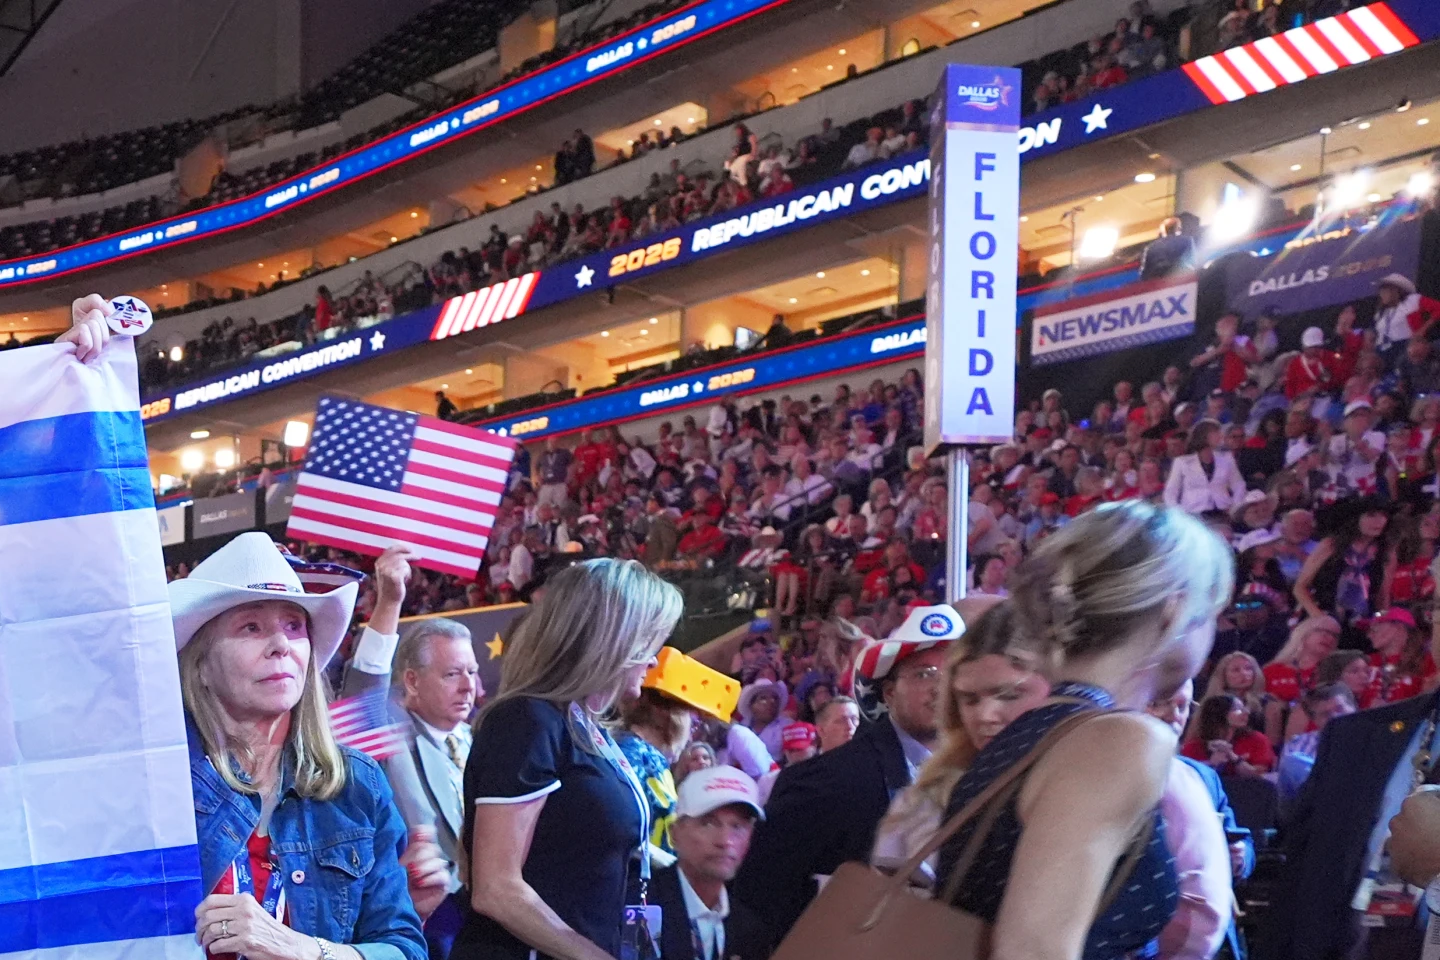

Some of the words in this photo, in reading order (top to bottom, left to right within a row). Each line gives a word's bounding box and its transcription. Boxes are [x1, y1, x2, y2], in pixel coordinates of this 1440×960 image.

[958, 85, 1000, 100] DALLAS
[607, 238, 681, 277] 2026
[691, 183, 854, 254] REPUBLICAN
[966, 152, 997, 416] FLORIDA
[1249, 266, 1329, 297] DALLAS
[1038, 292, 1189, 347] NEWSMAX
[142, 398, 171, 419] 026
[174, 370, 260, 410] REPUBLICAN
[261, 337, 361, 383] CONVENTION
[639, 383, 690, 407] DALLAS
[200, 509, 228, 524] DALLAS
[626, 909, 636, 925] 2
